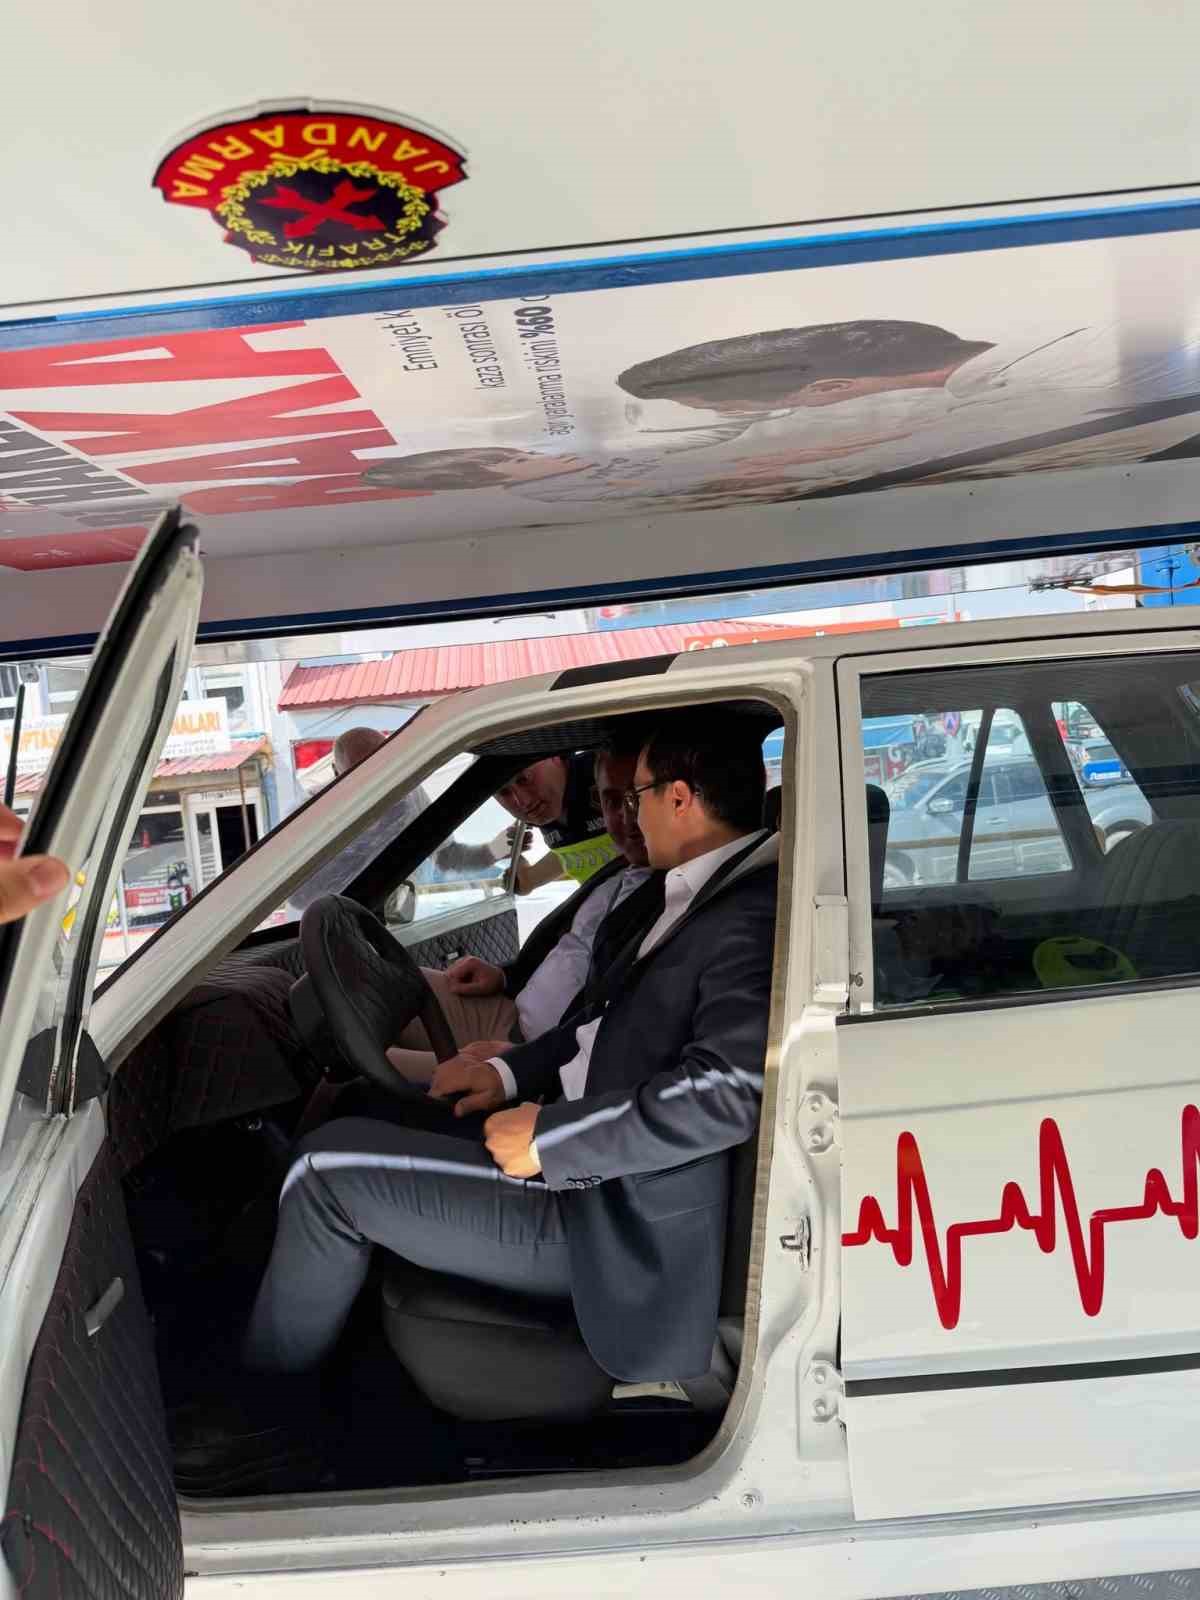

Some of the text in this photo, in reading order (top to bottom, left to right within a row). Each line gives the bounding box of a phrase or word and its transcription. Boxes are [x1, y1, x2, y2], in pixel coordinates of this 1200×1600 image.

[172, 122, 449, 198] JANDARMA
[282, 232, 406, 258] TRAFİK
[513, 306, 555, 338] %60
[381, 321, 438, 371] Emniyet
[458, 321, 499, 364] sonrası
[521, 339, 561, 373] riskini
[472, 365, 507, 390] kaza
[536, 373, 575, 421] yaralanma
